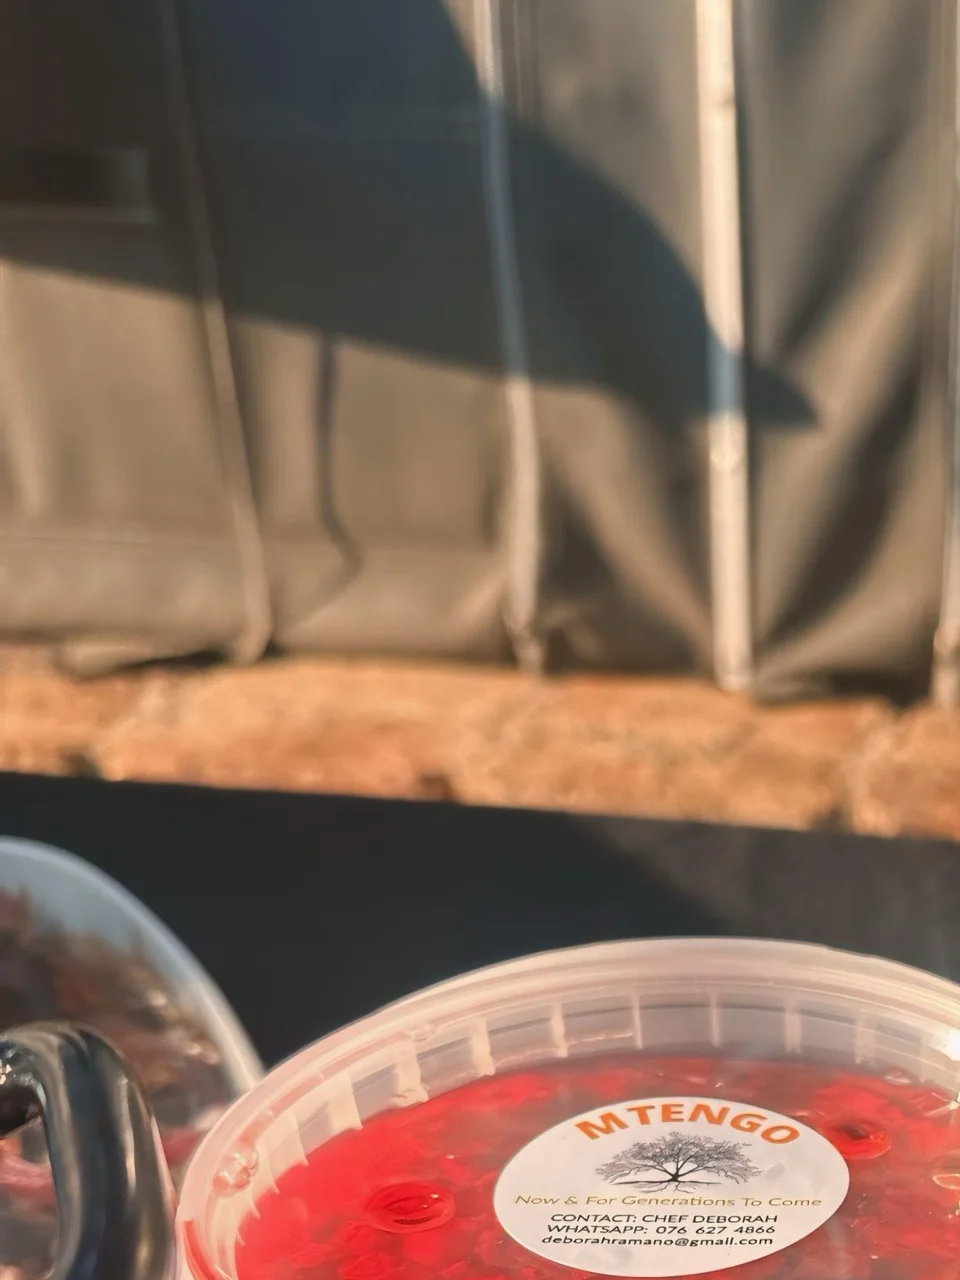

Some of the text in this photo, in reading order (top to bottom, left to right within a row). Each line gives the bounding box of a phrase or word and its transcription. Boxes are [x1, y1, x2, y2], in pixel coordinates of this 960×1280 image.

[574, 1103, 800, 1145] MTENGO
[515, 1195, 822, 1208] Now & For Generations To Come
[550, 1213, 779, 1224] CONTACT: CHEF DEBORAH
[546, 1224, 776, 1235] WHATSAPP: 076 627 4866
[541, 1235, 774, 1248] deborahramano@gmail.com
